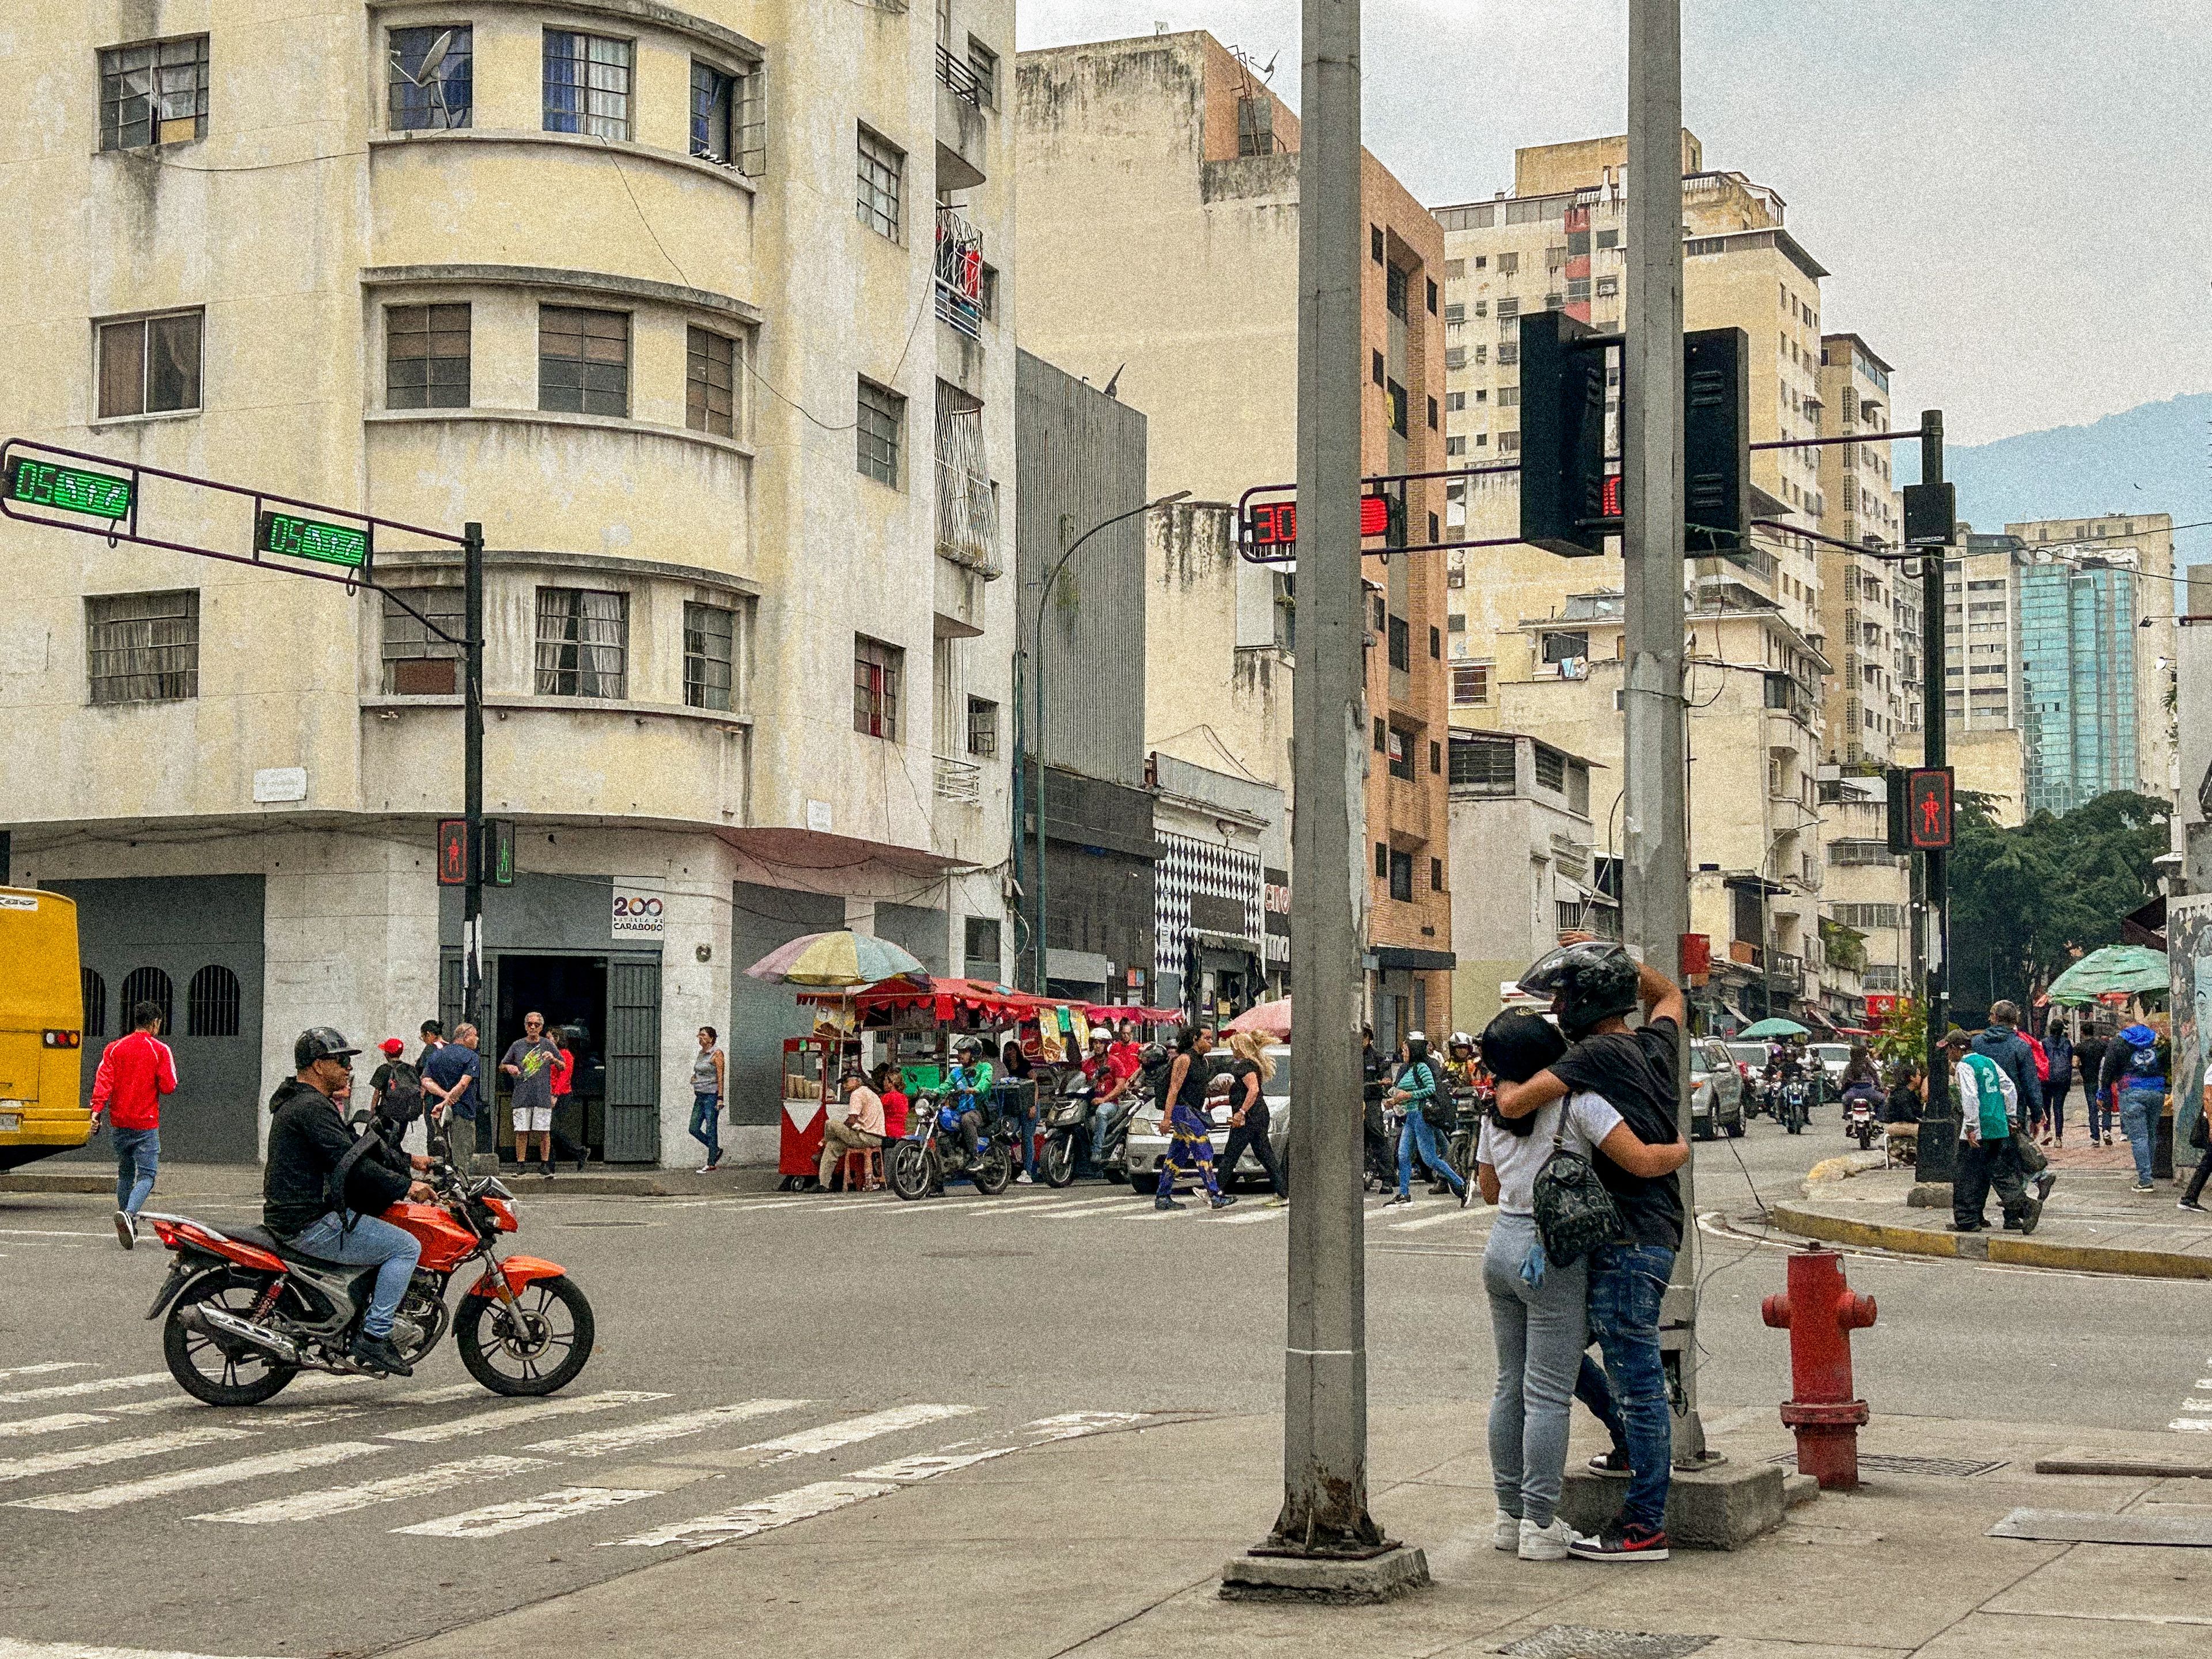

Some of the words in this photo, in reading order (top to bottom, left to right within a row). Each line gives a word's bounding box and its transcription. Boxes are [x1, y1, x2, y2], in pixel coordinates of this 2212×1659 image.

[16, 463, 56, 503] 05
[270, 517, 304, 554] 05
[1256, 505, 1296, 544] 30
[613, 896, 663, 916] 200
[1982, 1067, 1998, 1093] 2
